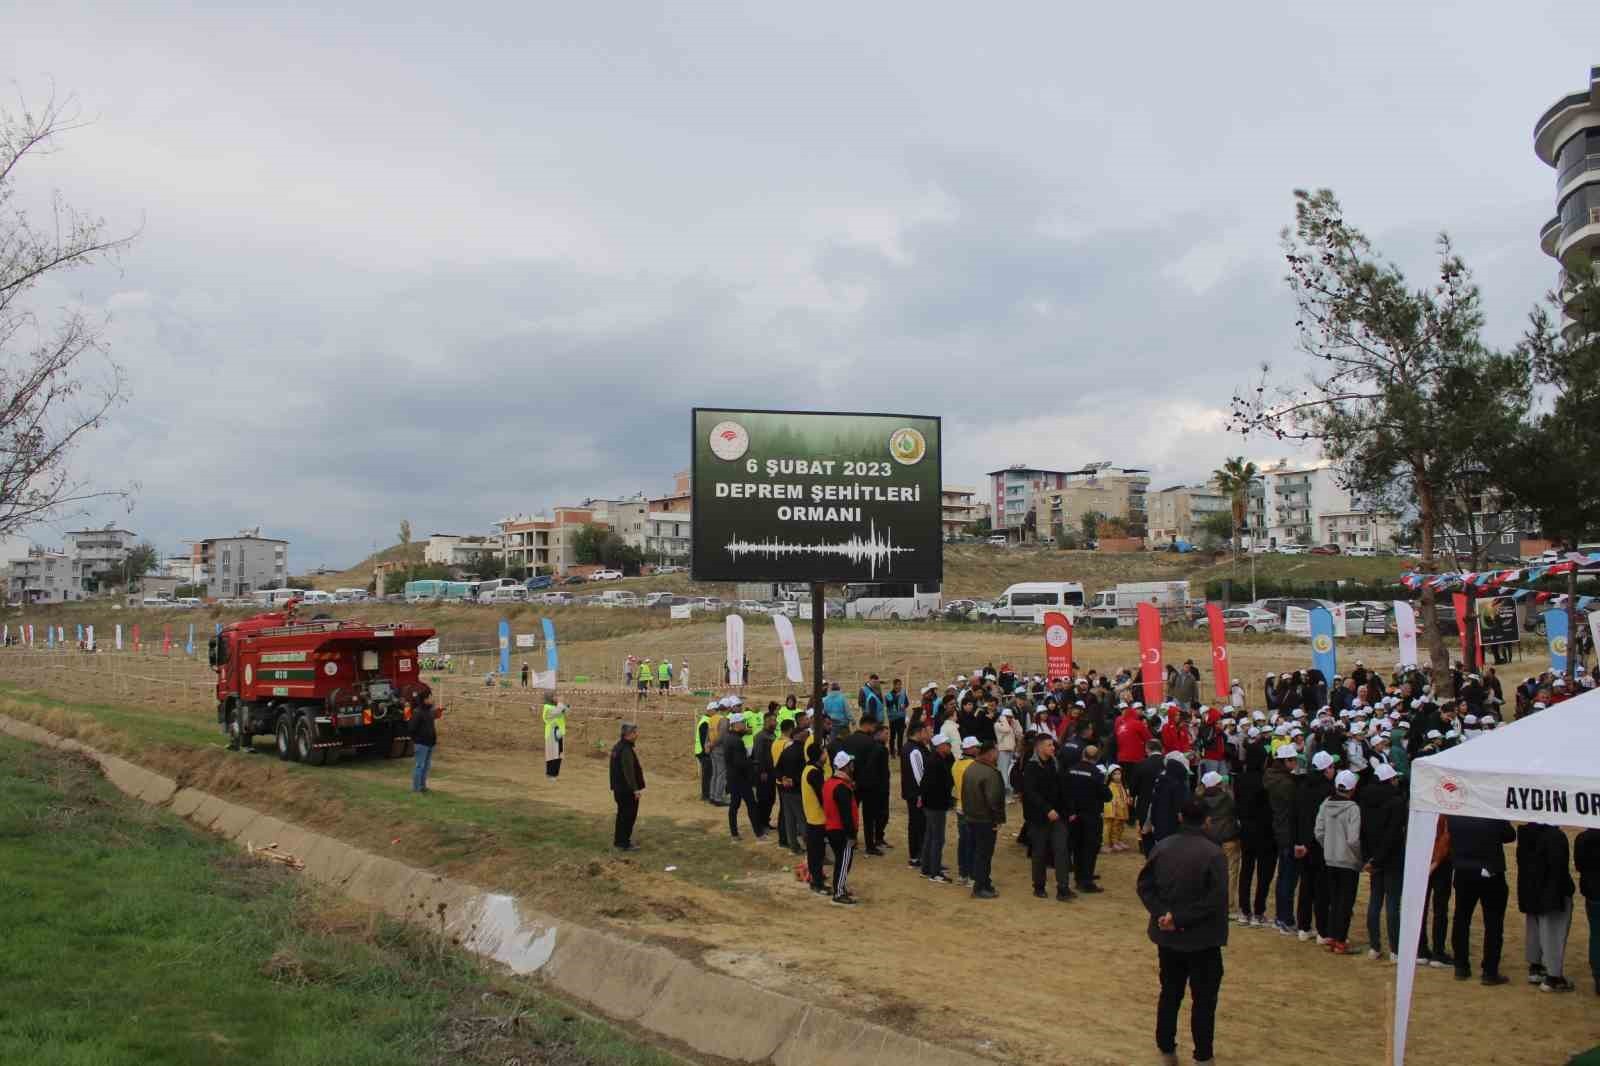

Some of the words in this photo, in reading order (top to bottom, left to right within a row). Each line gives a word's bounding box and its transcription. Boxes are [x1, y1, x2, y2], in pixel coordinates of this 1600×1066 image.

[746, 459, 758, 473] 6
[766, 459, 836, 478] ŞUBAT
[843, 462, 892, 477] 2023
[715, 483, 803, 499] DEPREM
[811, 482, 921, 503] ŞEHİTLERİ
[777, 506, 861, 522] ORMANI
[1505, 787, 1568, 814] AYDIN
